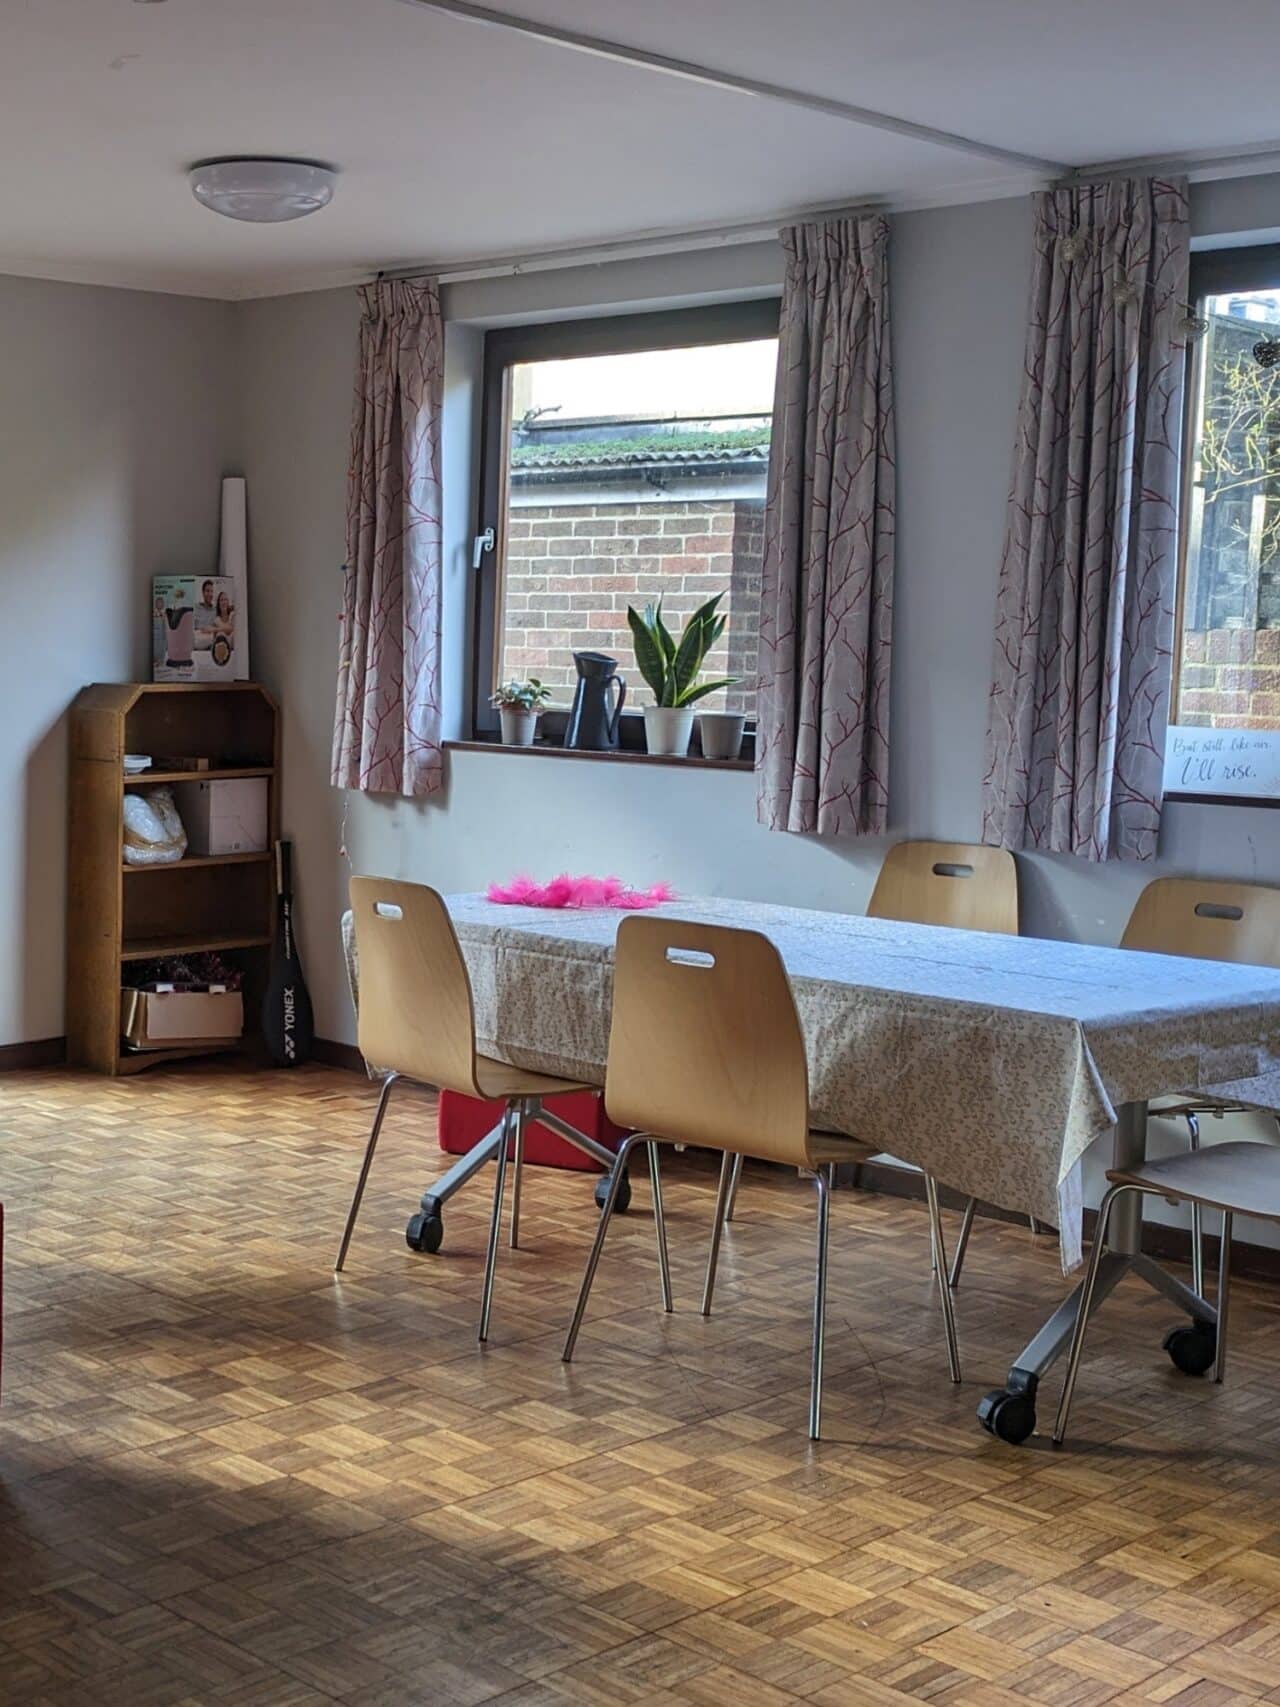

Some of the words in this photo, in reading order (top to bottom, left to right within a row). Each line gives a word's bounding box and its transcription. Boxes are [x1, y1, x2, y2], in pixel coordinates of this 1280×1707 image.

[1173, 737, 1197, 755] But
[1231, 736, 1249, 752] like
[1181, 756, 1216, 784] I'll
[284, 987, 296, 1031] YONEX
